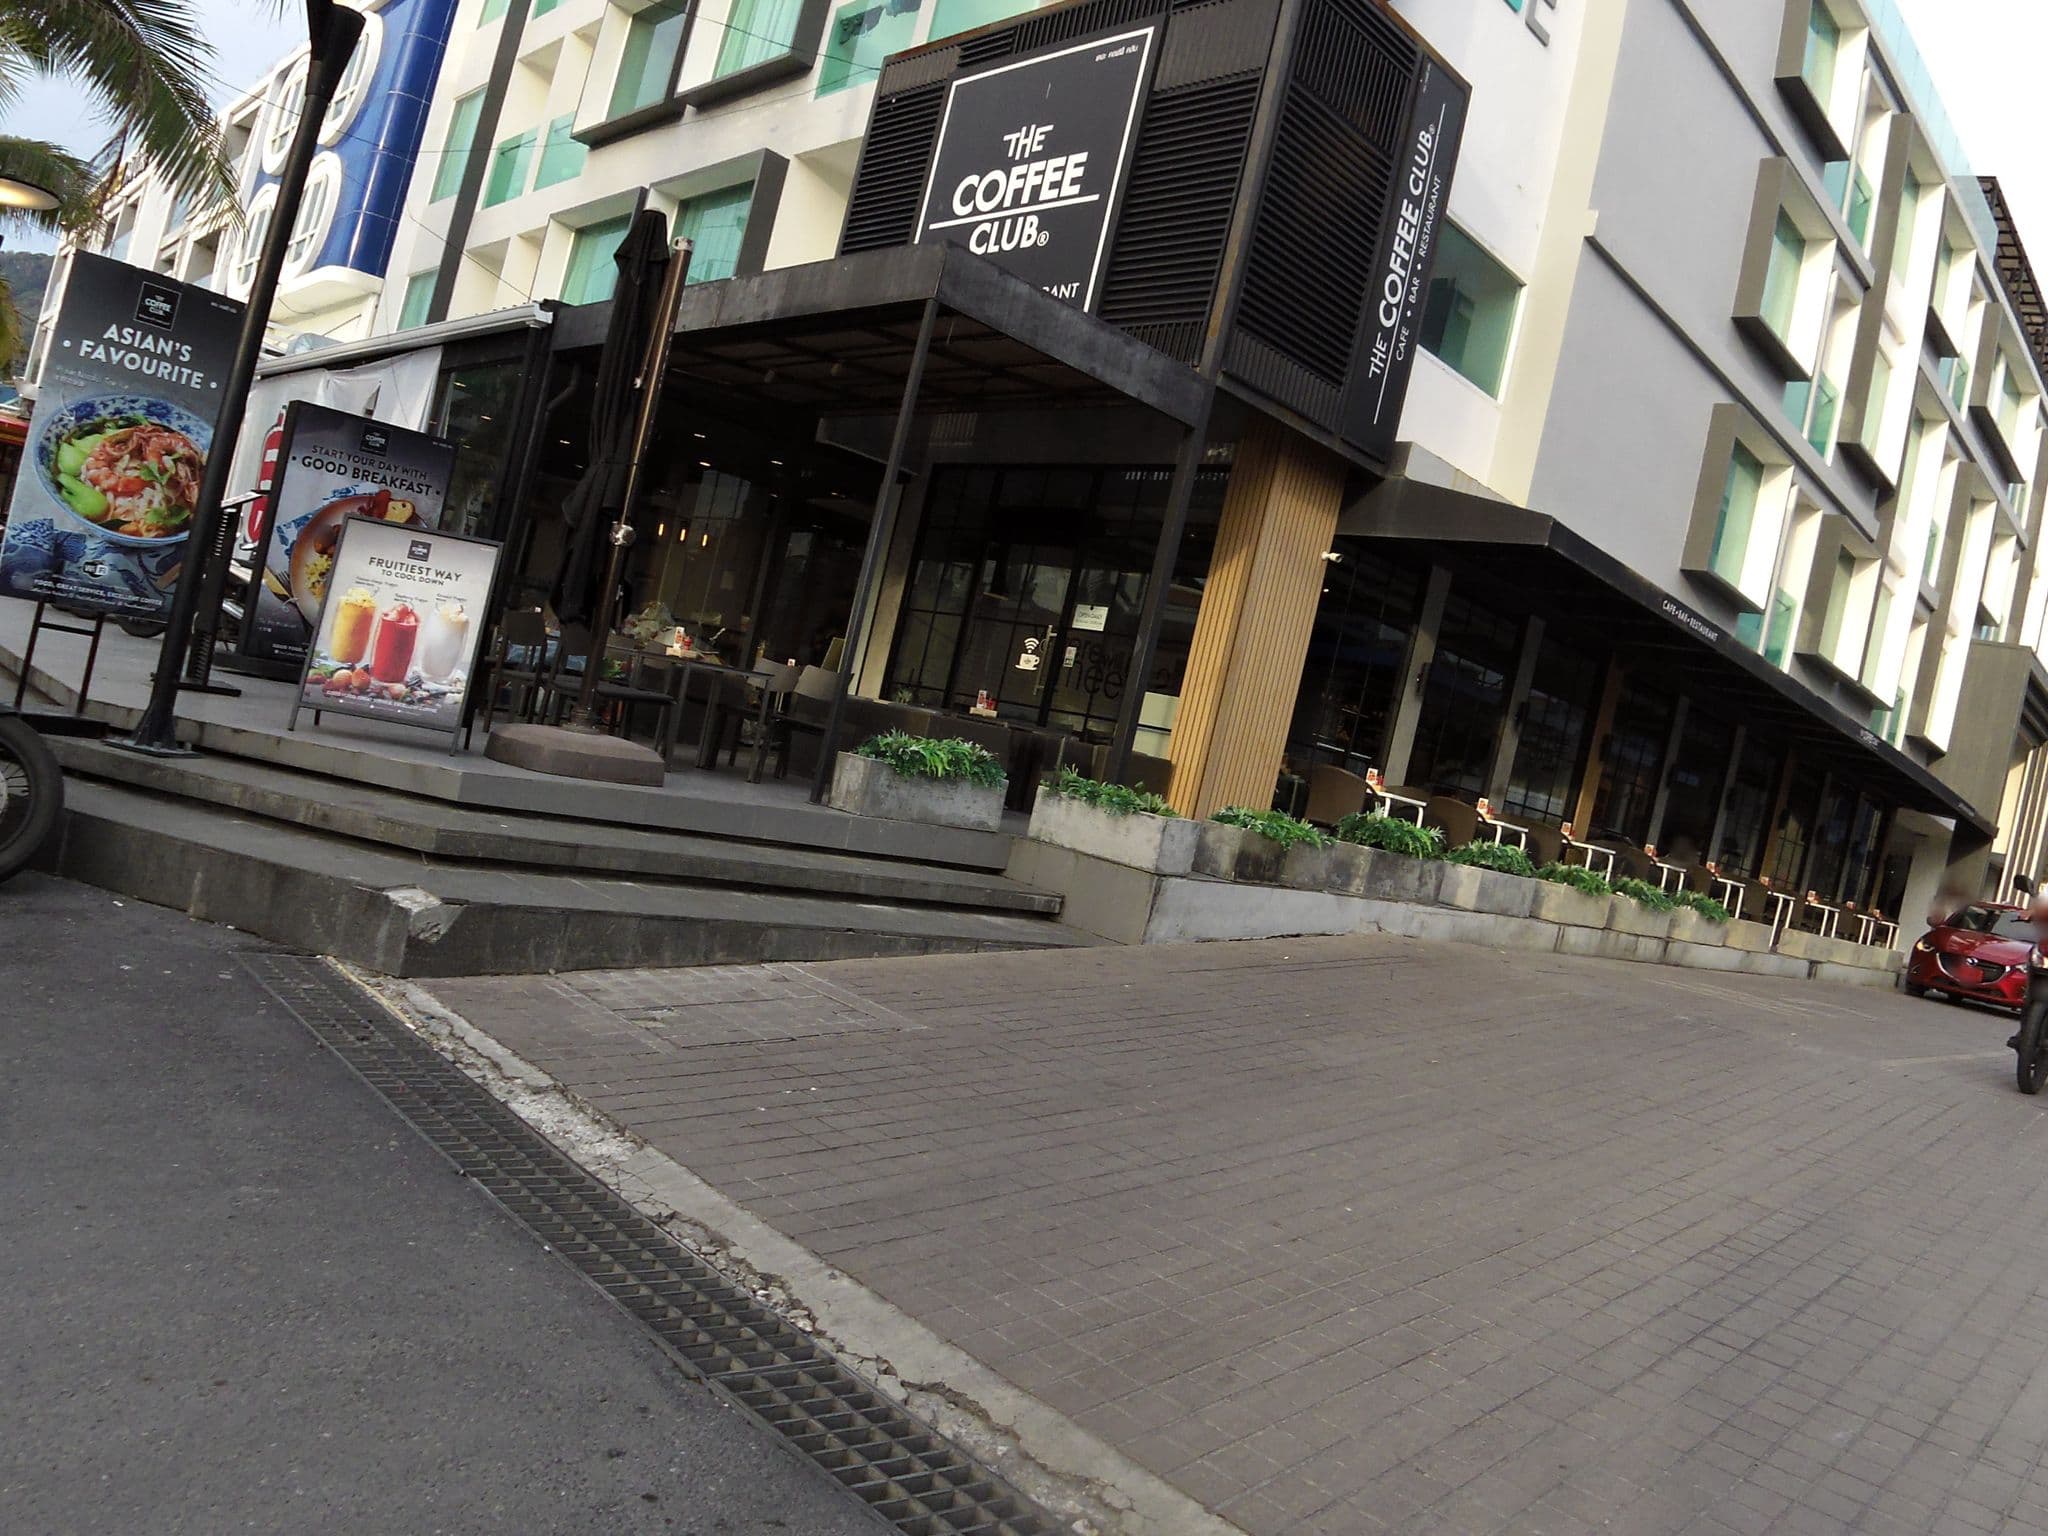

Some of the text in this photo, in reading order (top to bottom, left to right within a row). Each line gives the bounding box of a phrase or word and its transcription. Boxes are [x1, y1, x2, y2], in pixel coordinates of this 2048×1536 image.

[1003, 124, 1055, 160] THE
[952, 151, 1088, 217] COFFEE
[1396, 174, 1442, 361] CAFE BAR RESTAURANT
[1368, 331, 1388, 378] THE
[1378, 198, 1420, 328] COFFEE
[102, 323, 192, 362] ASIAN'S
[78, 339, 204, 389] FAVOURITE
[301, 456, 433, 496] GOOD BREAKFAST
[311, 444, 427, 480] START YOUR DAY WITH
[368, 556, 462, 582] FRUITIEST WAY
[381, 568, 393, 577] TO
[394, 571, 417, 582] COOL
[418, 576, 445, 586] DOWN
